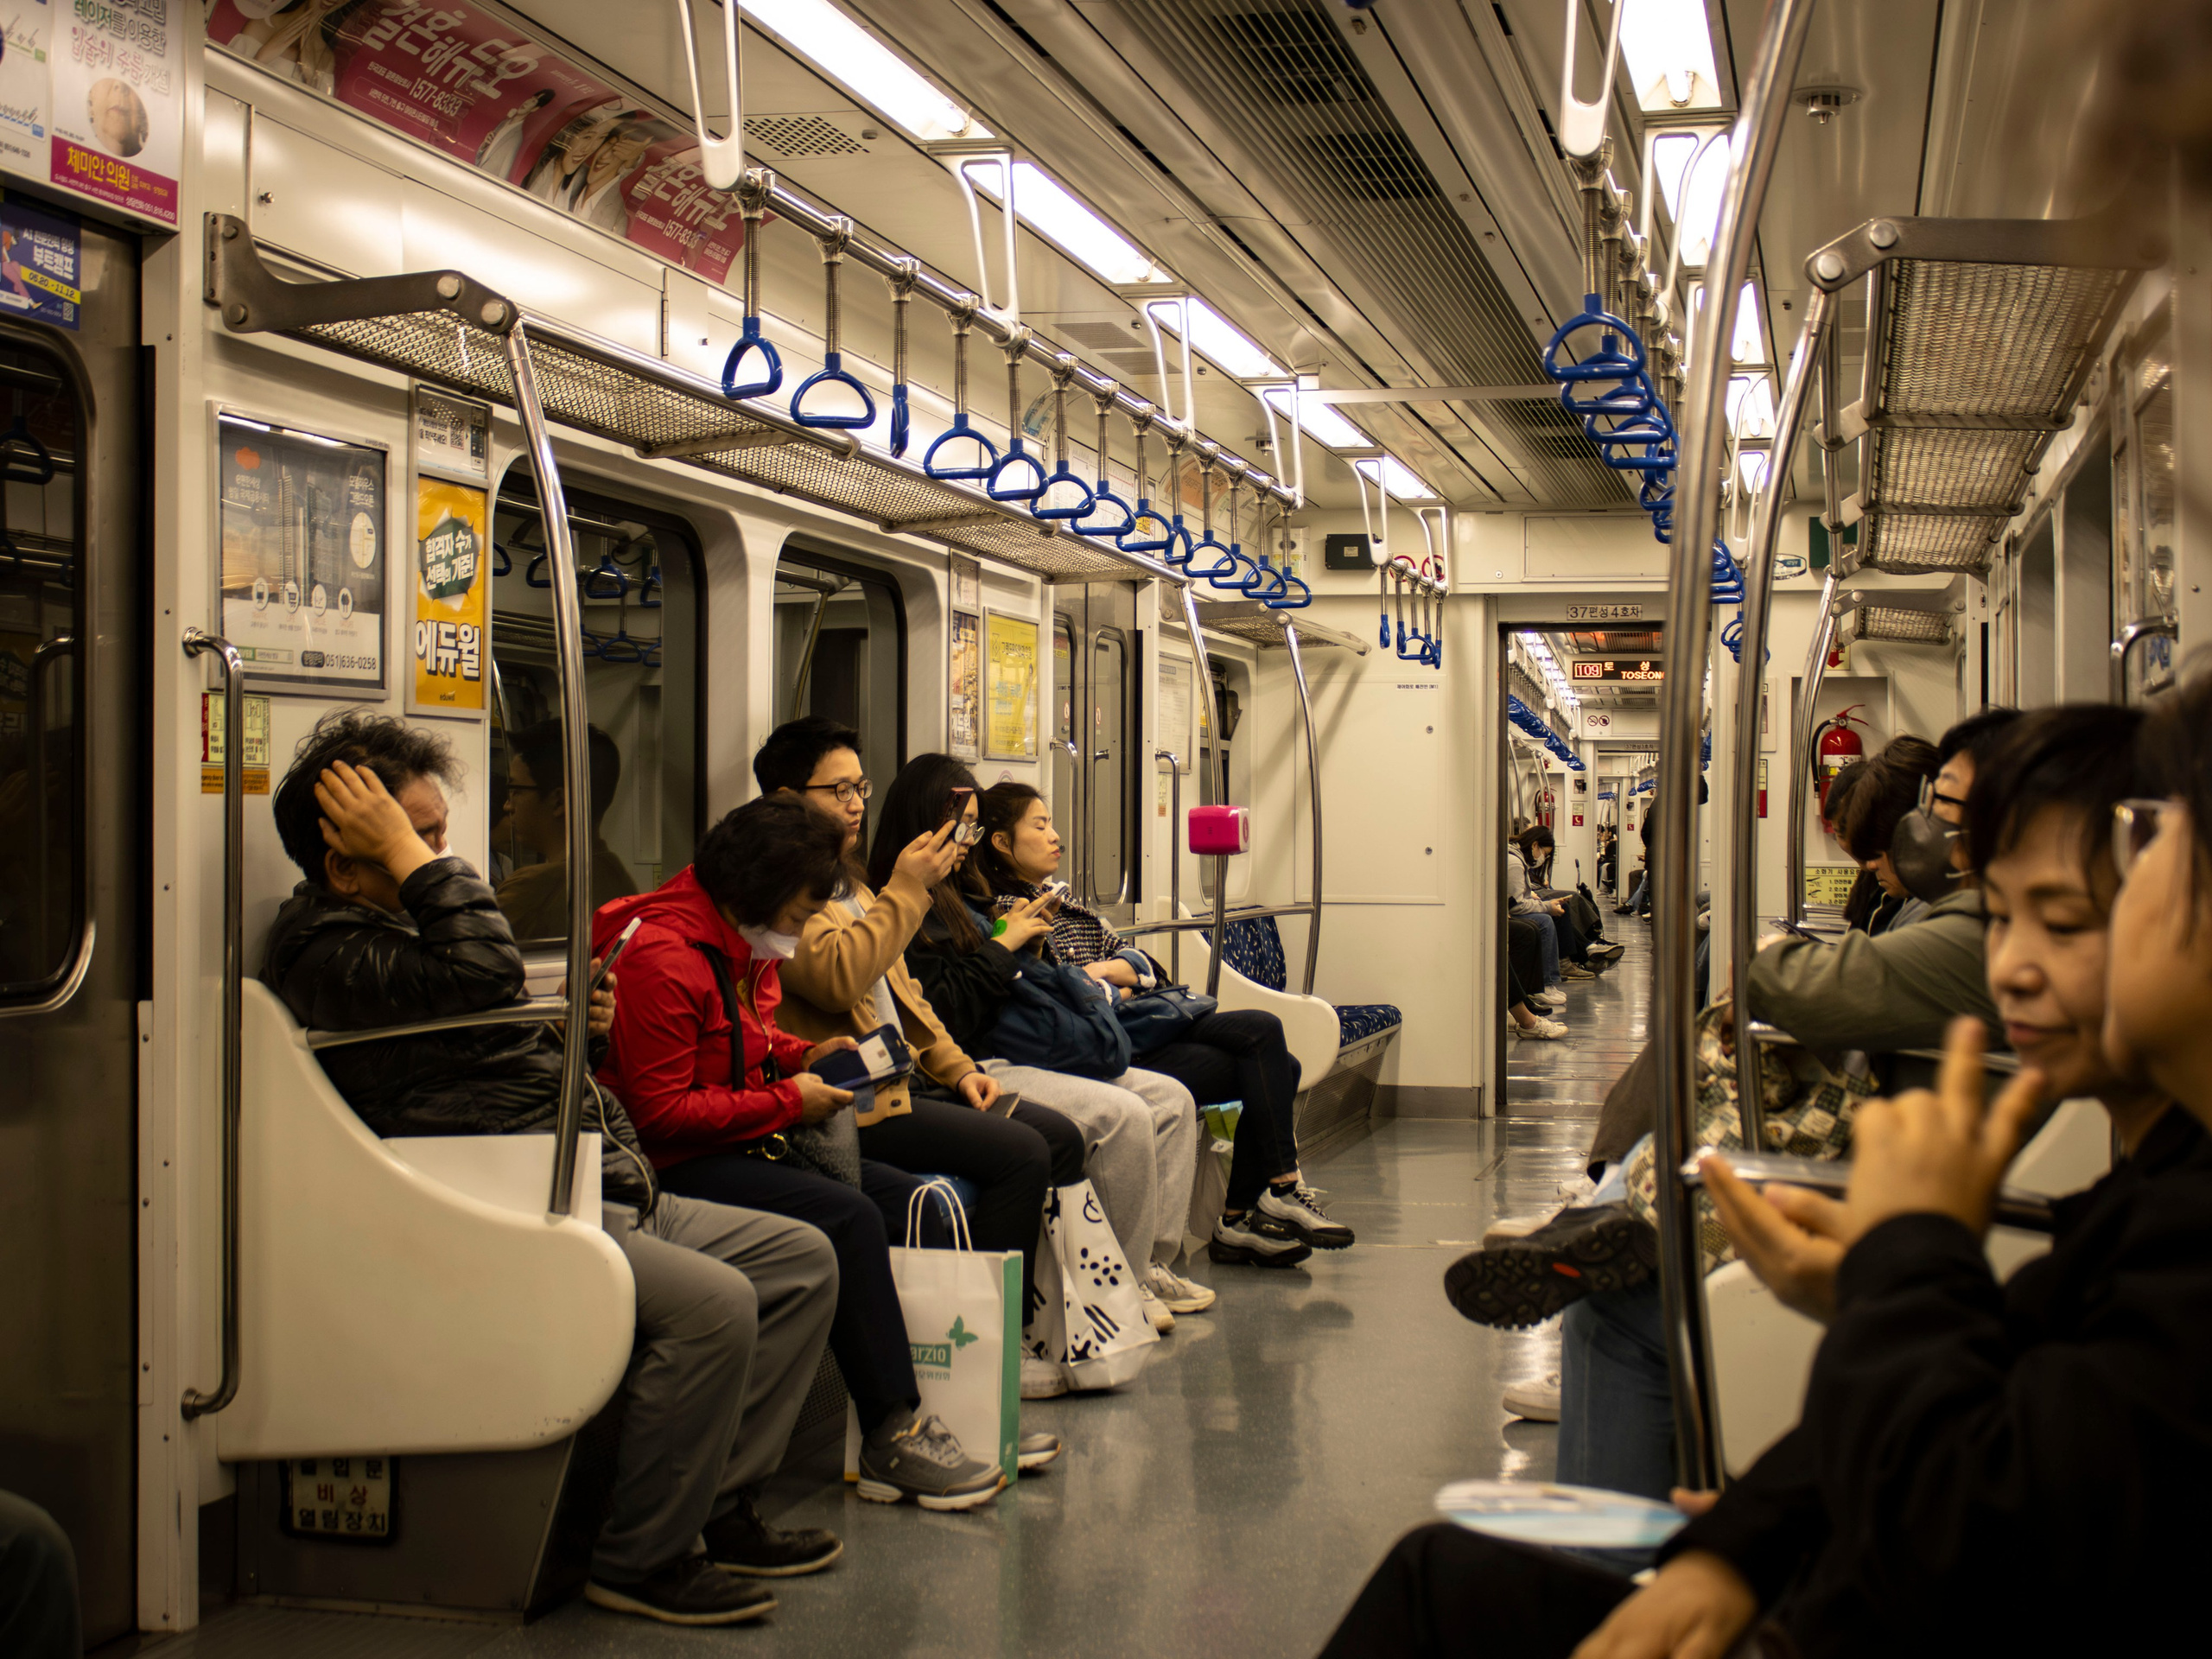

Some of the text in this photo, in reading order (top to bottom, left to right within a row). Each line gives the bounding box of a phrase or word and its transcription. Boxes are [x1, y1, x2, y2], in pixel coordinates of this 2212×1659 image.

[129, 18, 166, 57] 이용한
[71, 26, 113, 69] 입술위
[117, 47, 143, 86] 주름
[409, 77, 462, 117] 1577-8333
[67, 146, 104, 182] 체미안
[106, 161, 130, 192] 의원
[33, 245, 74, 281] 부트캠프
[426, 532, 454, 563] 합격자
[426, 552, 474, 590] 선택의 기준!
[325, 653, 378, 671] 051)636-0258
[1576, 664, 1600, 677] 109
[316, 1483, 368, 1506] 비상
[299, 1508, 386, 1533] 열림장치
